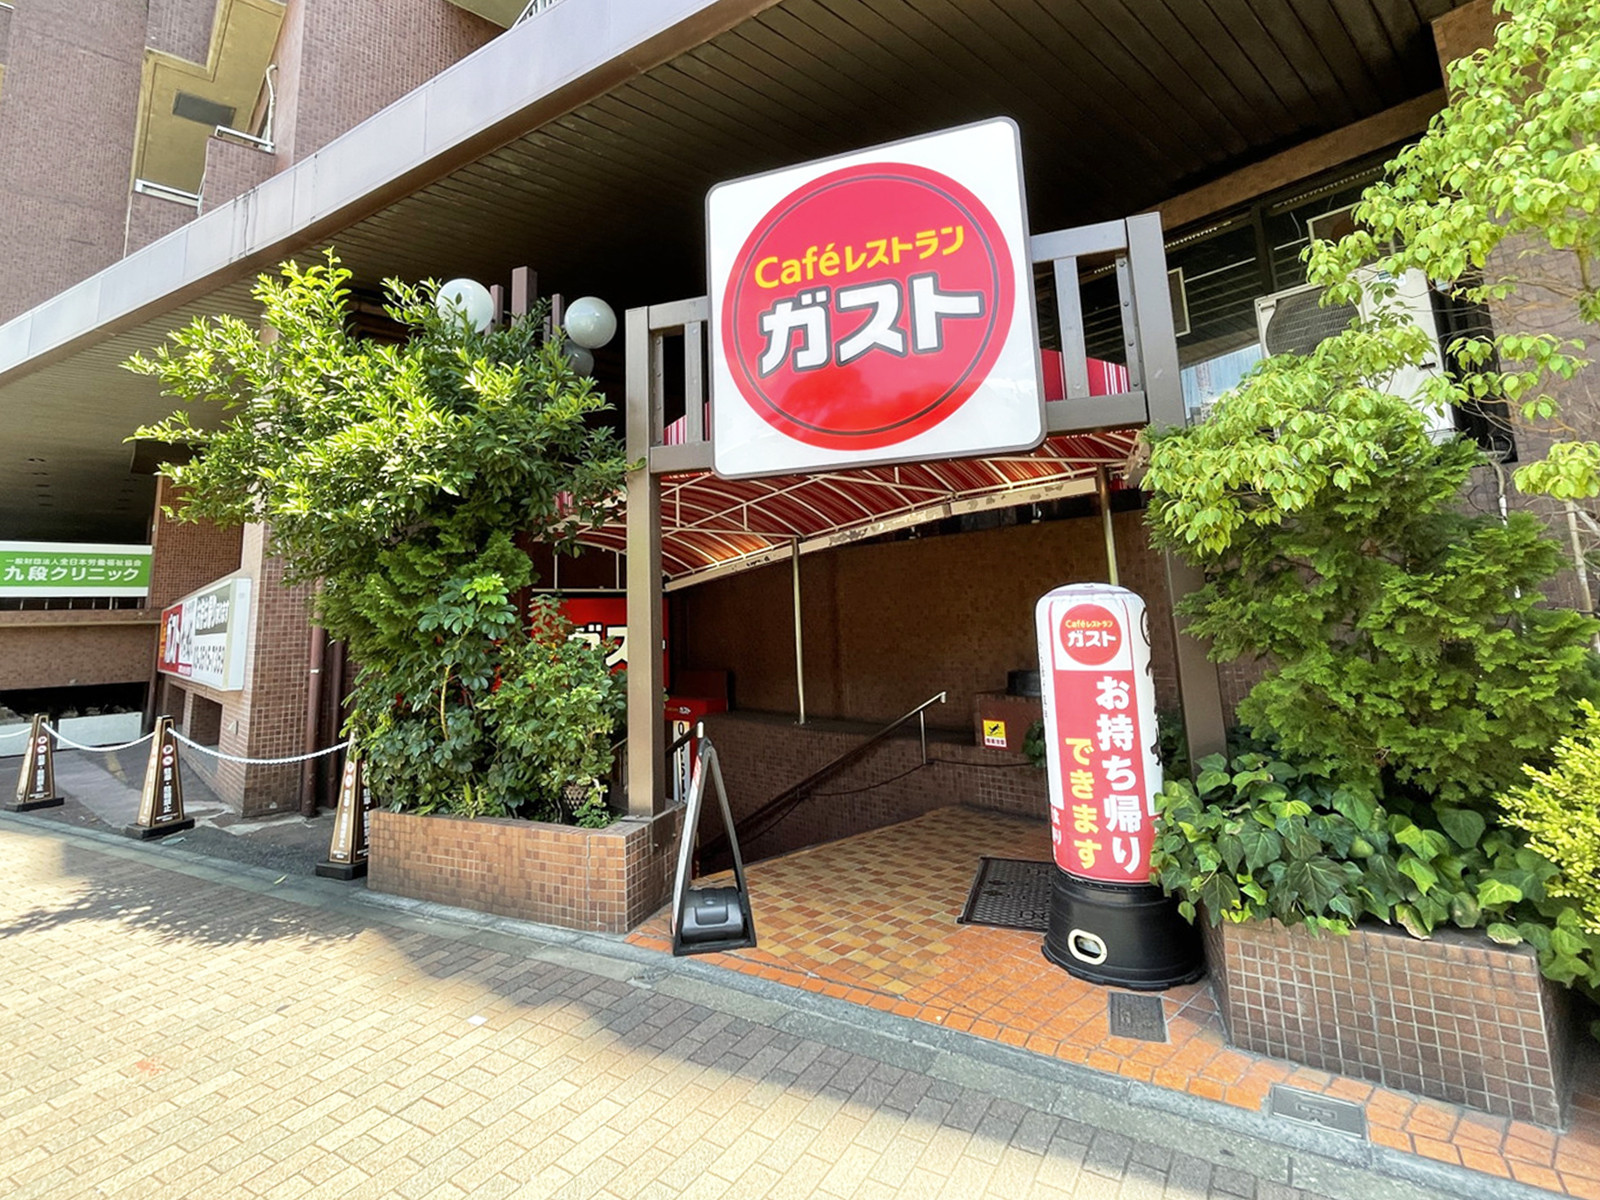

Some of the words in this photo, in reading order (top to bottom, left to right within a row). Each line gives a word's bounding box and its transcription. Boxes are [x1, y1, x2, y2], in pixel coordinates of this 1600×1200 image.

[758, 272, 984, 378] ガスト
[3, 565, 140, 581] 九段クリニック
[1067, 630, 1117, 648] ガスト
[1065, 737, 1103, 870] できます
[1095, 675, 1142, 875] お持ち帰り
